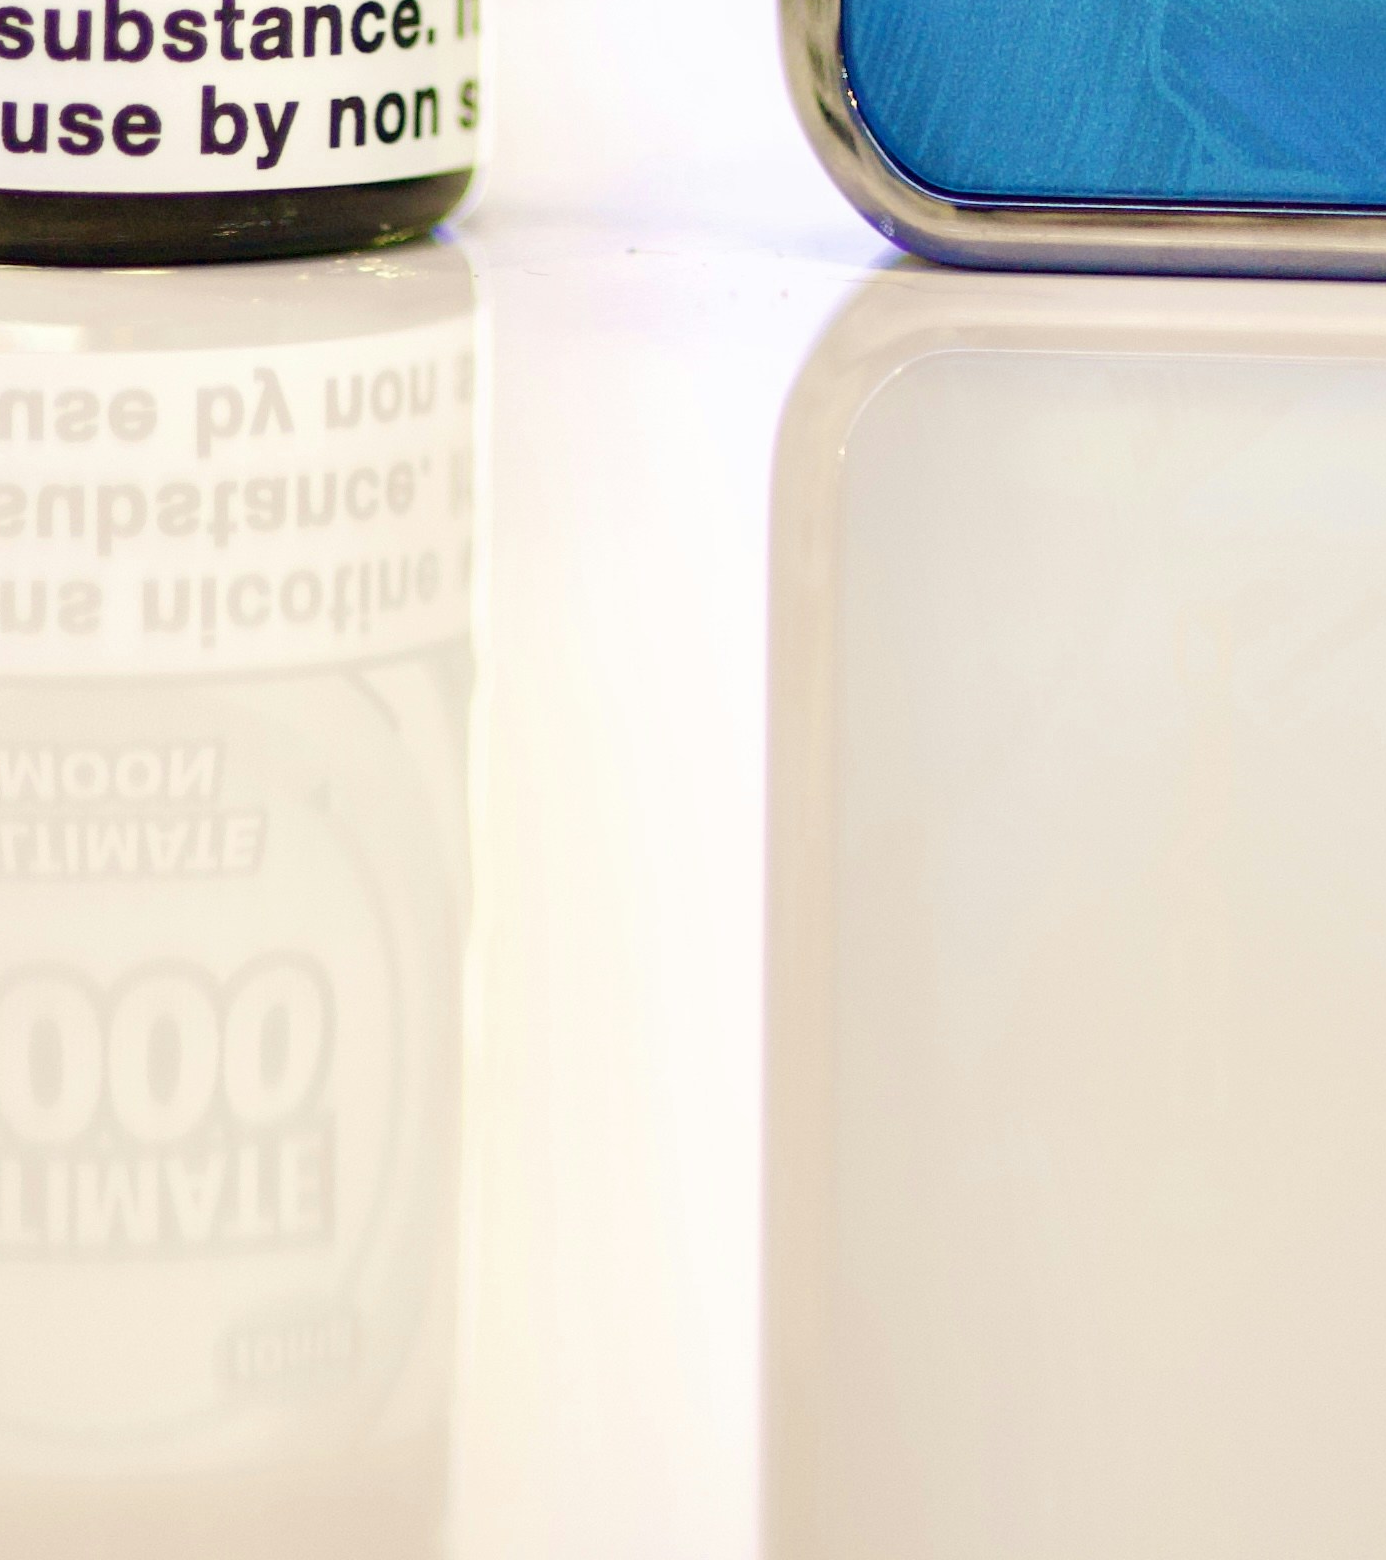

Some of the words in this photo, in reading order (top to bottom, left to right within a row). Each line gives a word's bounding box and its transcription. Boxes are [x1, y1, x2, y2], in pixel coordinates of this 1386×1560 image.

[0, 102, 162, 157] use
[199, 84, 300, 171] by
[328, 86, 440, 149] non
